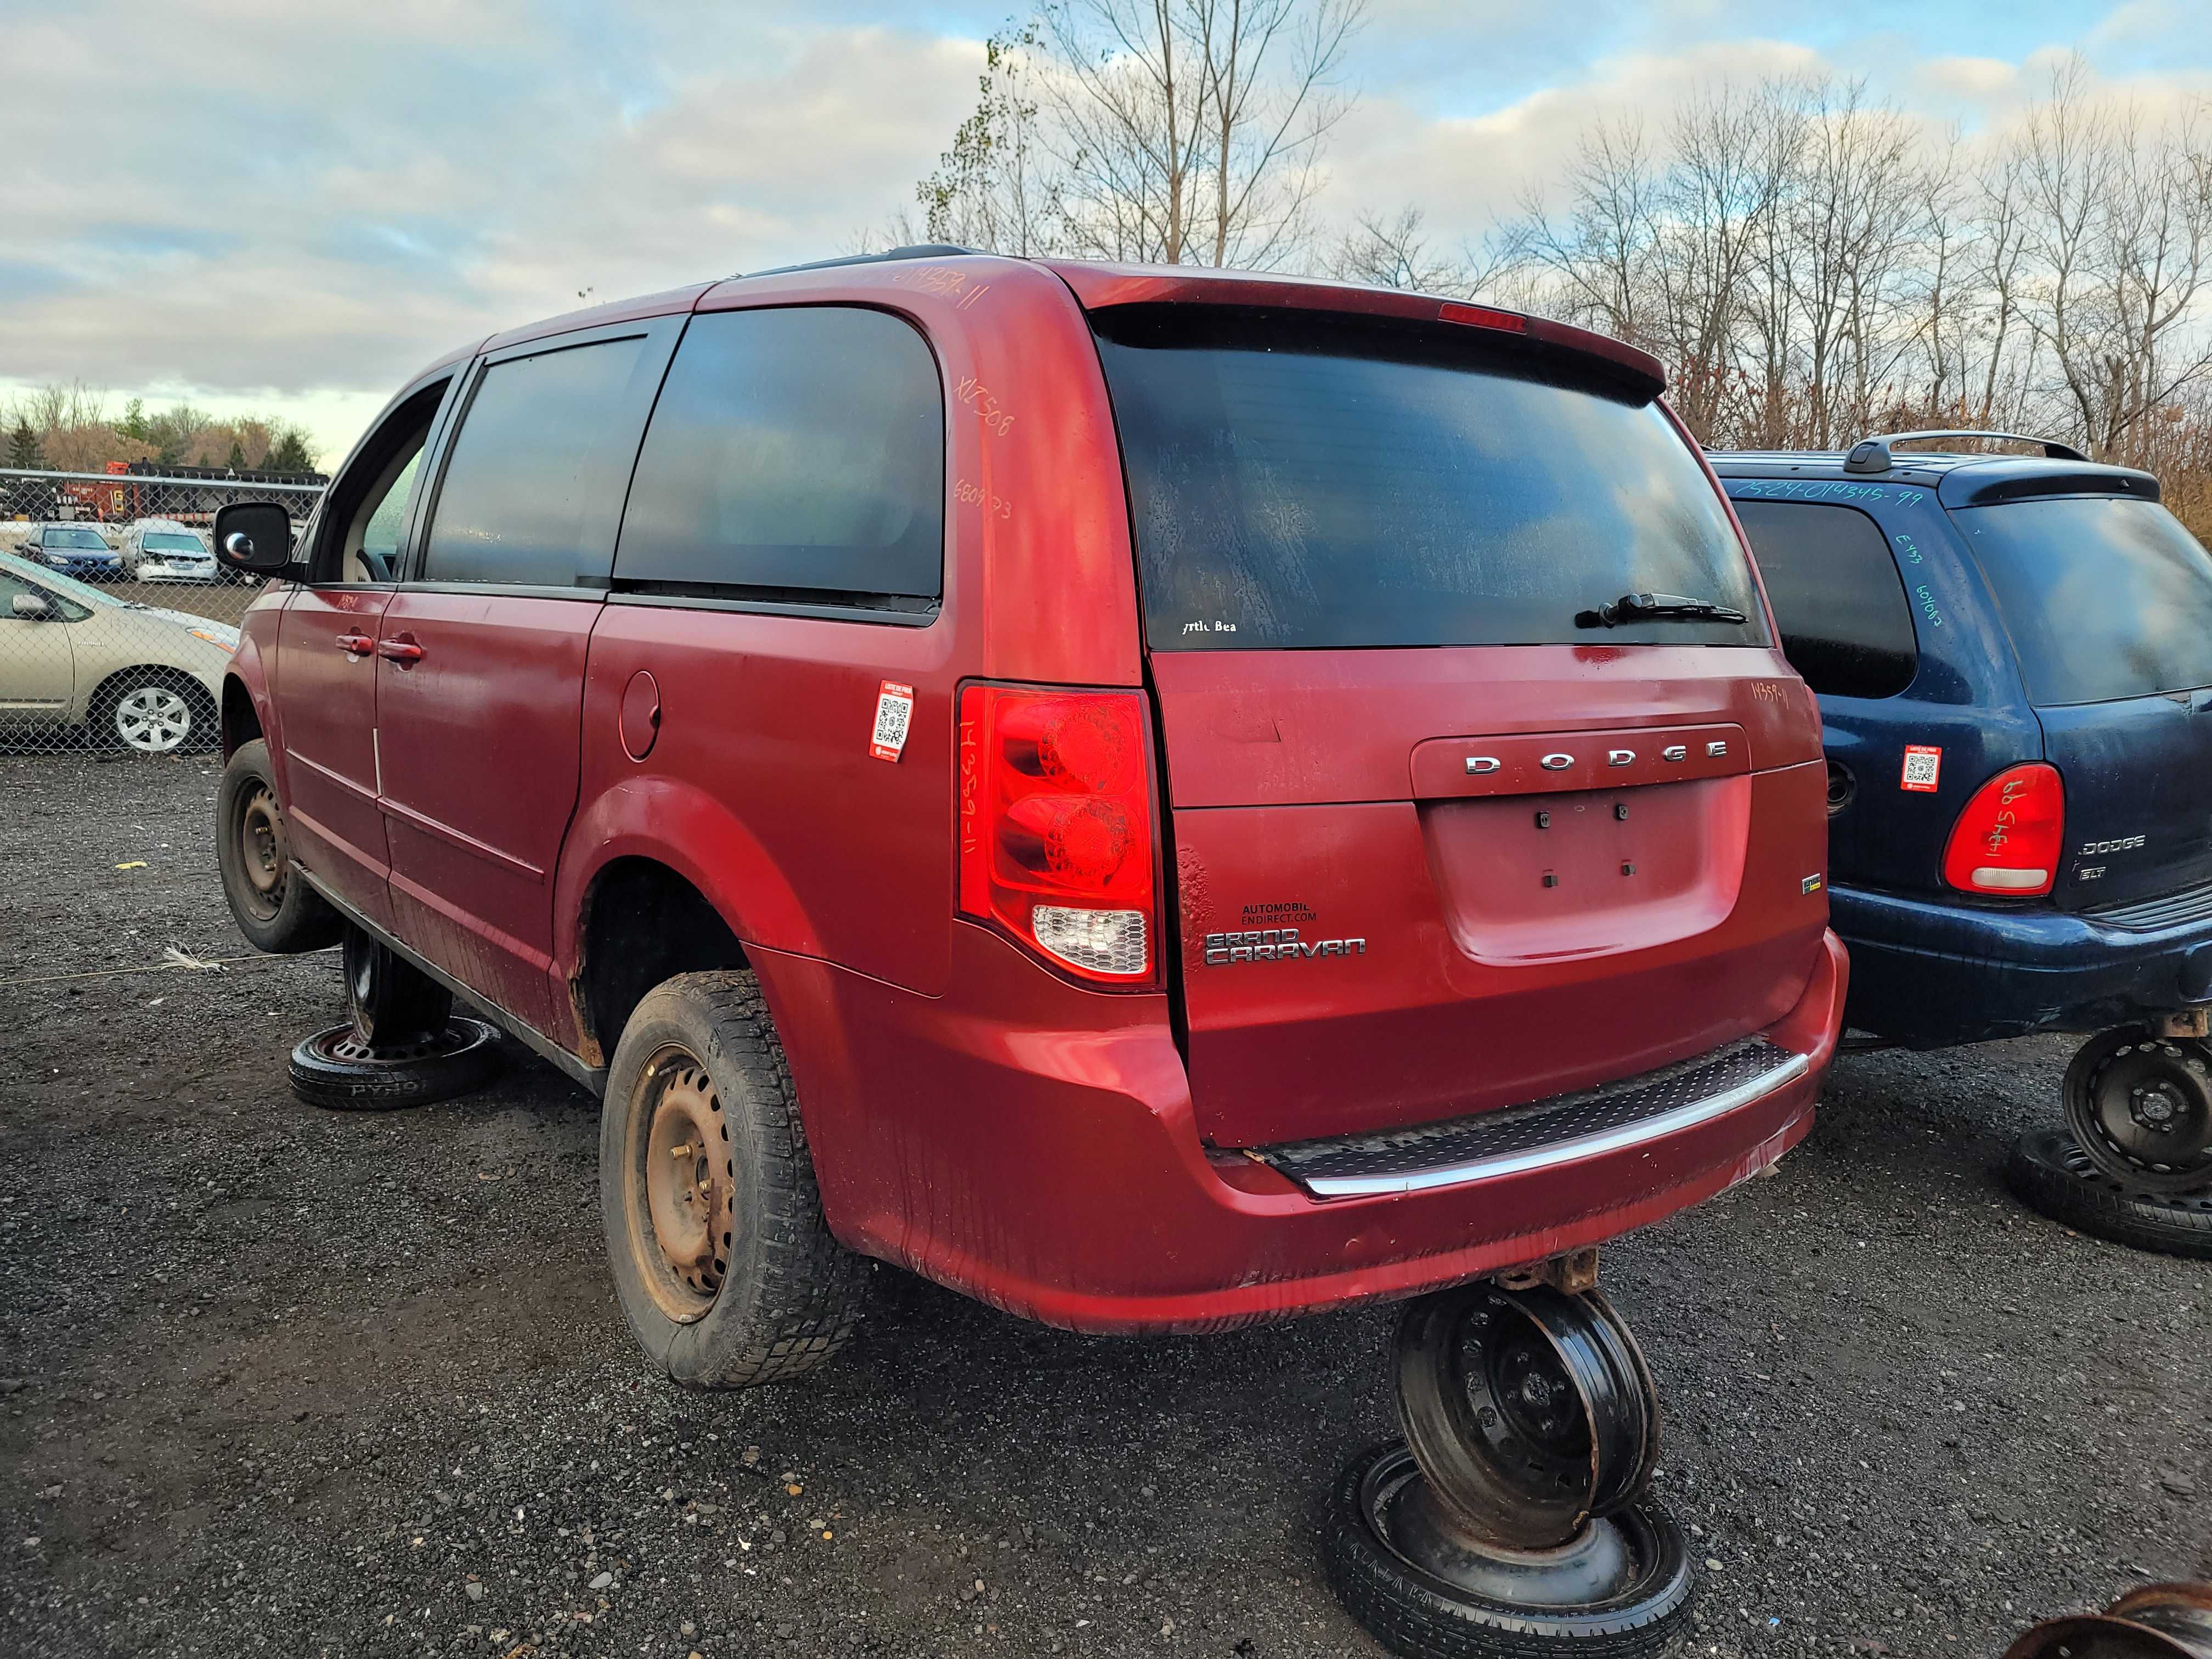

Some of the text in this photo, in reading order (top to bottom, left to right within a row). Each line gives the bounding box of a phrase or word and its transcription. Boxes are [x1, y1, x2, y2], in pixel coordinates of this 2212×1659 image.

[1465, 741, 1728, 775] DODGE
[2083, 834, 2146, 855] DODGE
[1206, 928, 1299, 947] GRAND
[1206, 938, 1365, 964] CARAVAN
